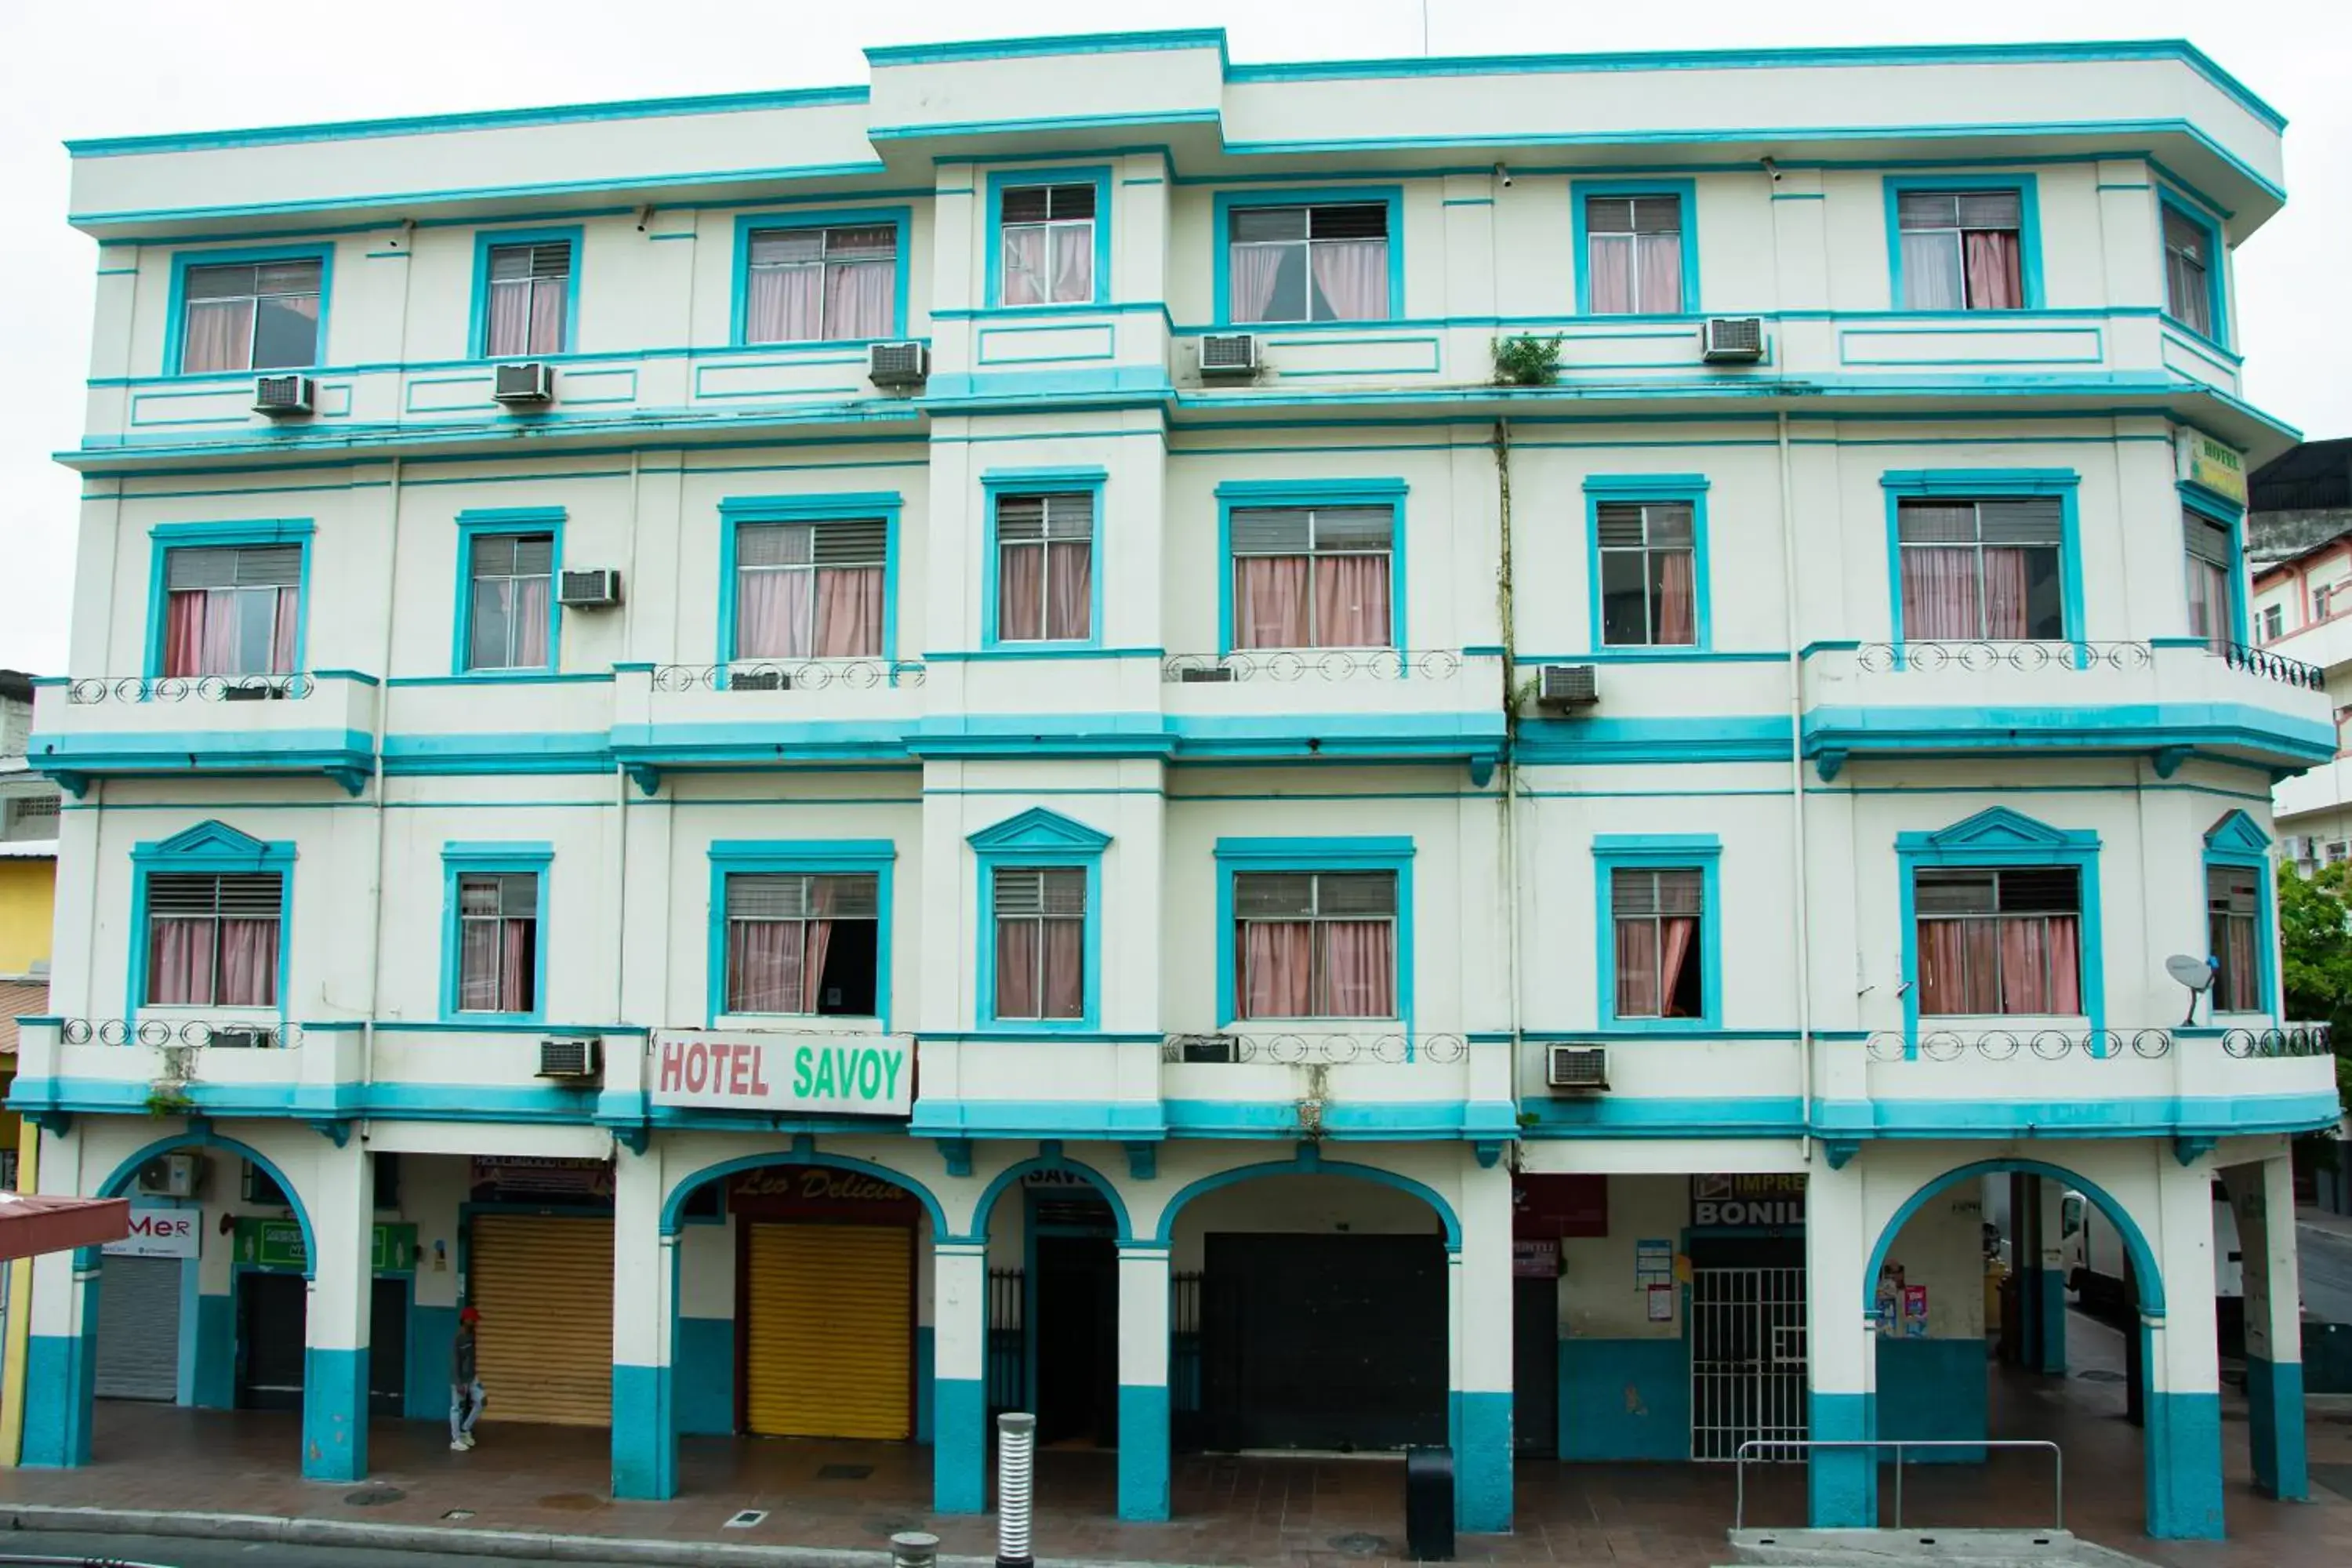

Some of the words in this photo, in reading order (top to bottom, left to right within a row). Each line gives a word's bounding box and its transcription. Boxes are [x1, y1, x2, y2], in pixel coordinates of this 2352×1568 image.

[2203, 440, 2241, 472] HOTEL
[659, 1042, 769, 1097] HOTEL
[793, 1046, 902, 1101] SAVOY
[1697, 1201, 1806, 1225] BONIL
